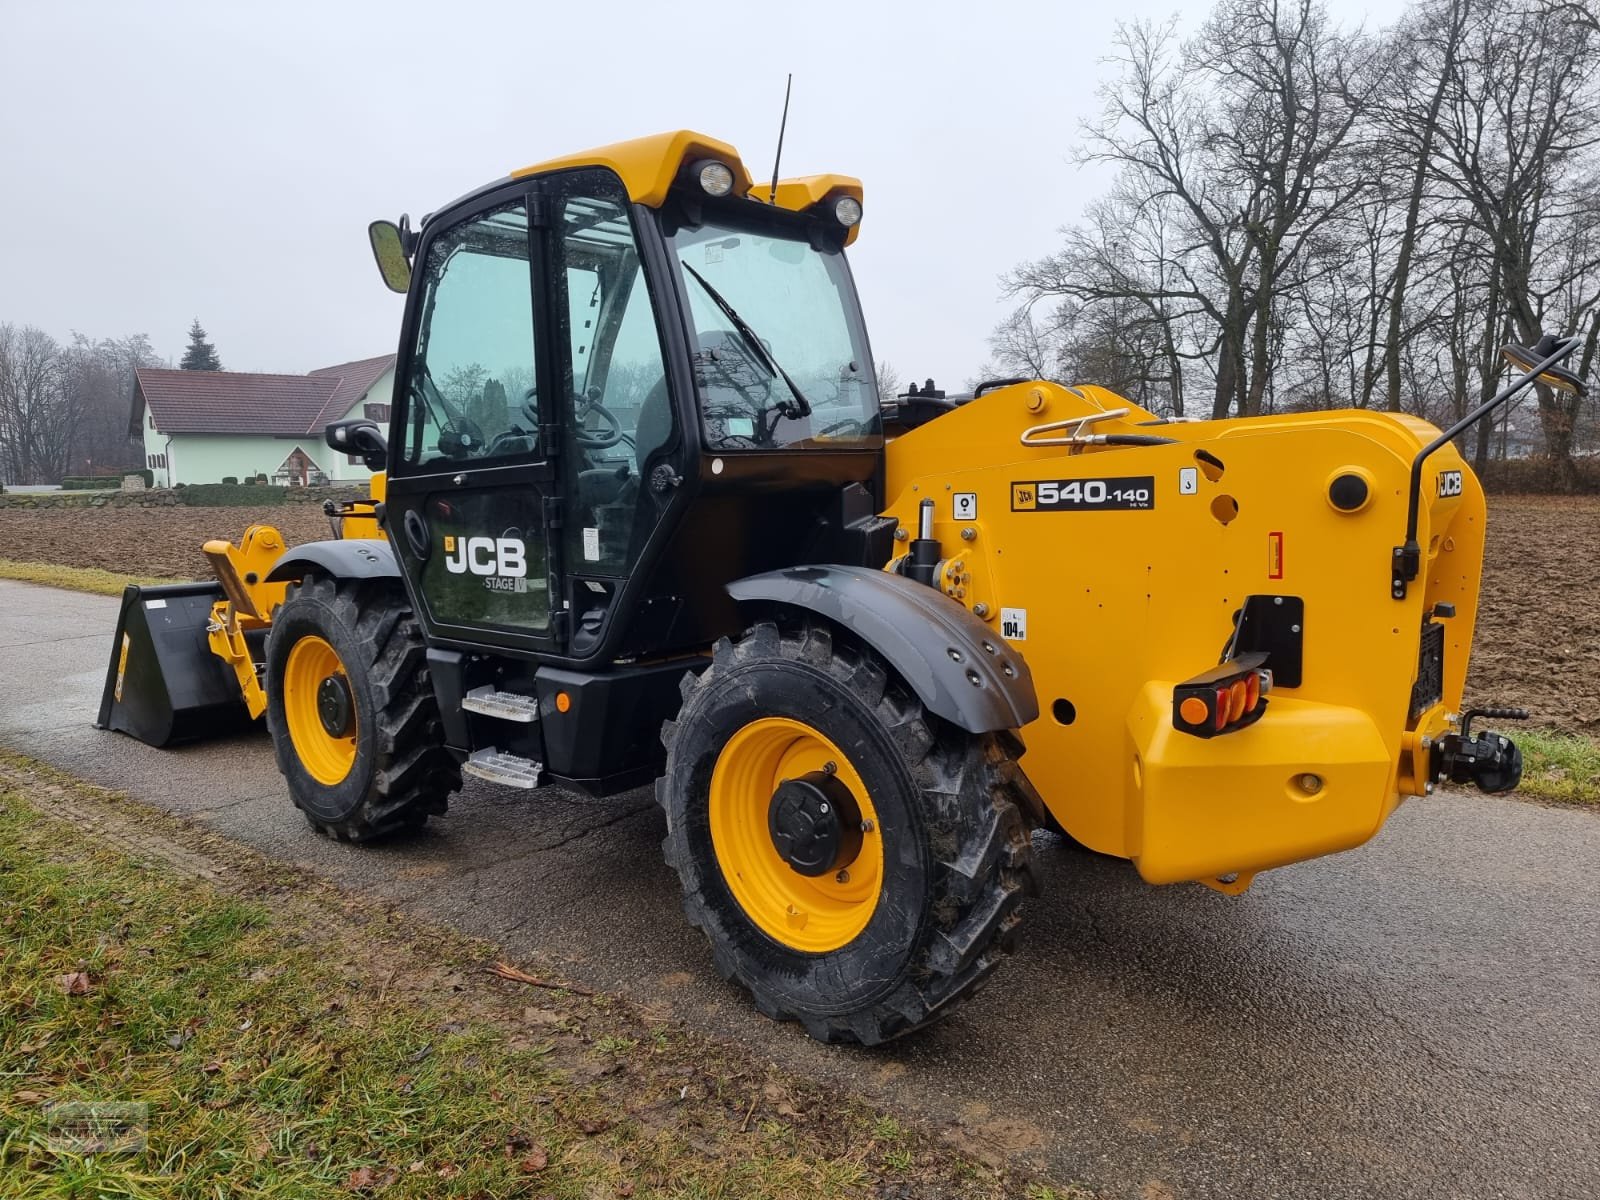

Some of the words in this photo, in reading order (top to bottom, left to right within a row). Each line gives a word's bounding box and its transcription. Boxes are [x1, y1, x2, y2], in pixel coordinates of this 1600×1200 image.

[1016, 489, 1033, 504] JCB
[1037, 481, 1149, 504] 540-140
[1440, 472, 1461, 496] JCB
[445, 536, 527, 577] JCB
[485, 577, 514, 590] STAGE
[1003, 621, 1018, 637] 104
